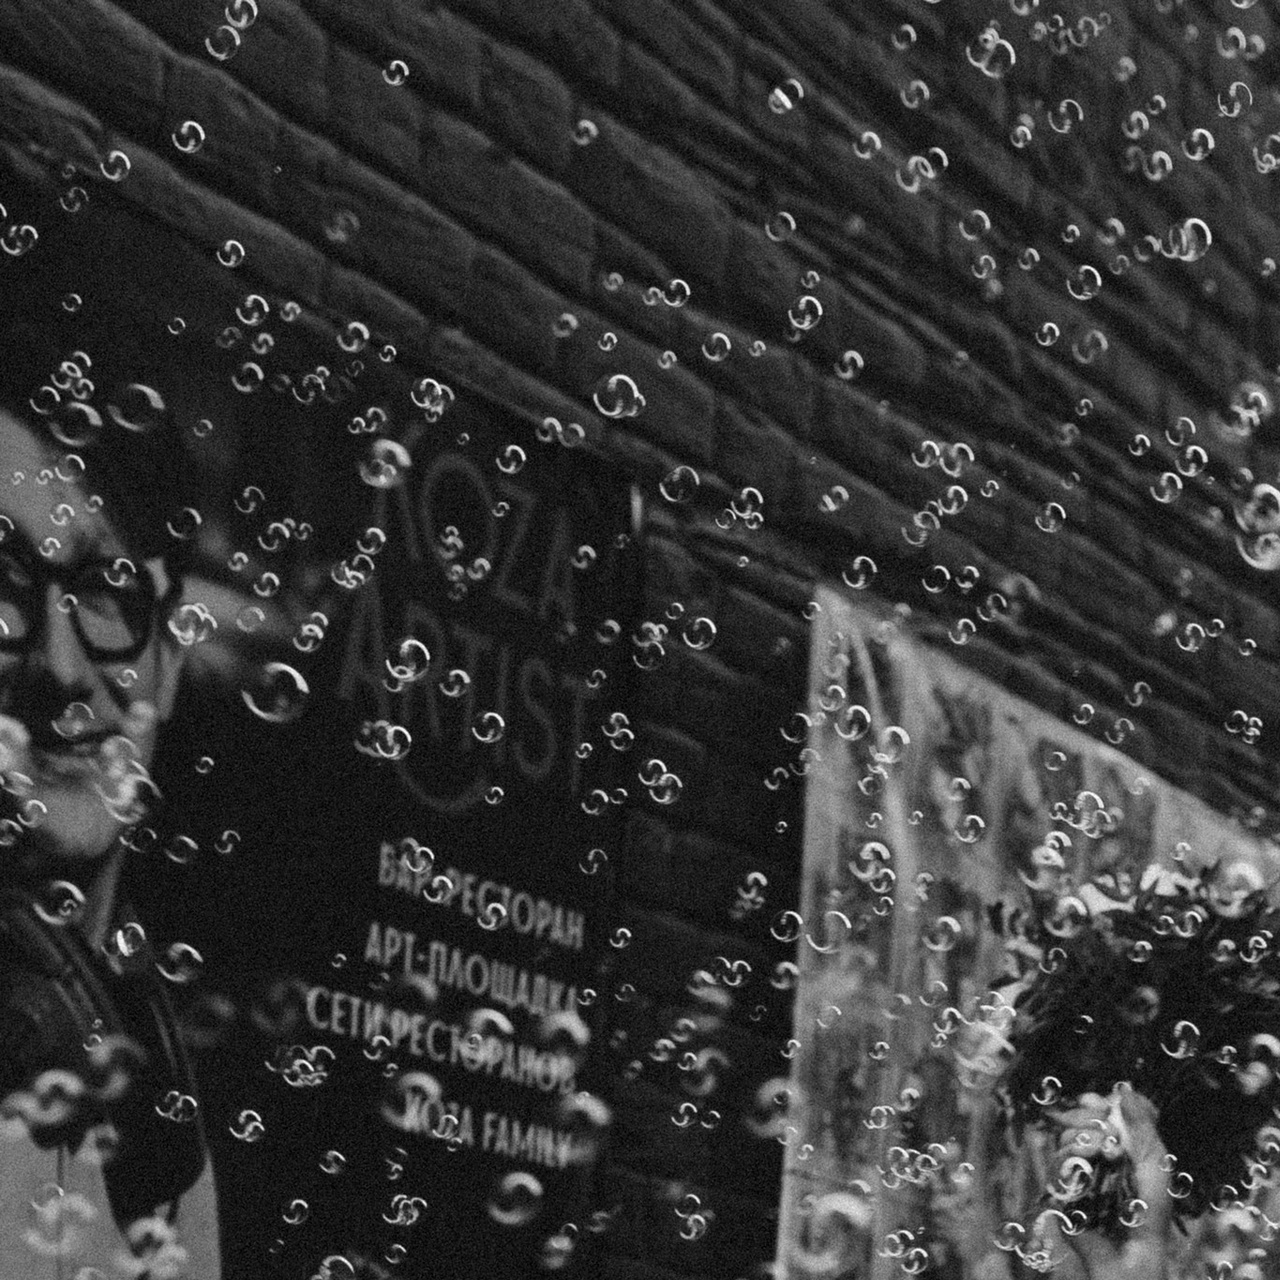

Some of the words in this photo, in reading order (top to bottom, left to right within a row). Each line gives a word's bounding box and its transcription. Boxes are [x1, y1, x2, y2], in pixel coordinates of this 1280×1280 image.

[337, 582, 600, 795] ARTIST
[379, 841, 584, 949] БАРРЕСТОРАН
[306, 985, 385, 1041] СЕТИ
[389, 1008, 576, 1095] РЕСТОРАНОВ
